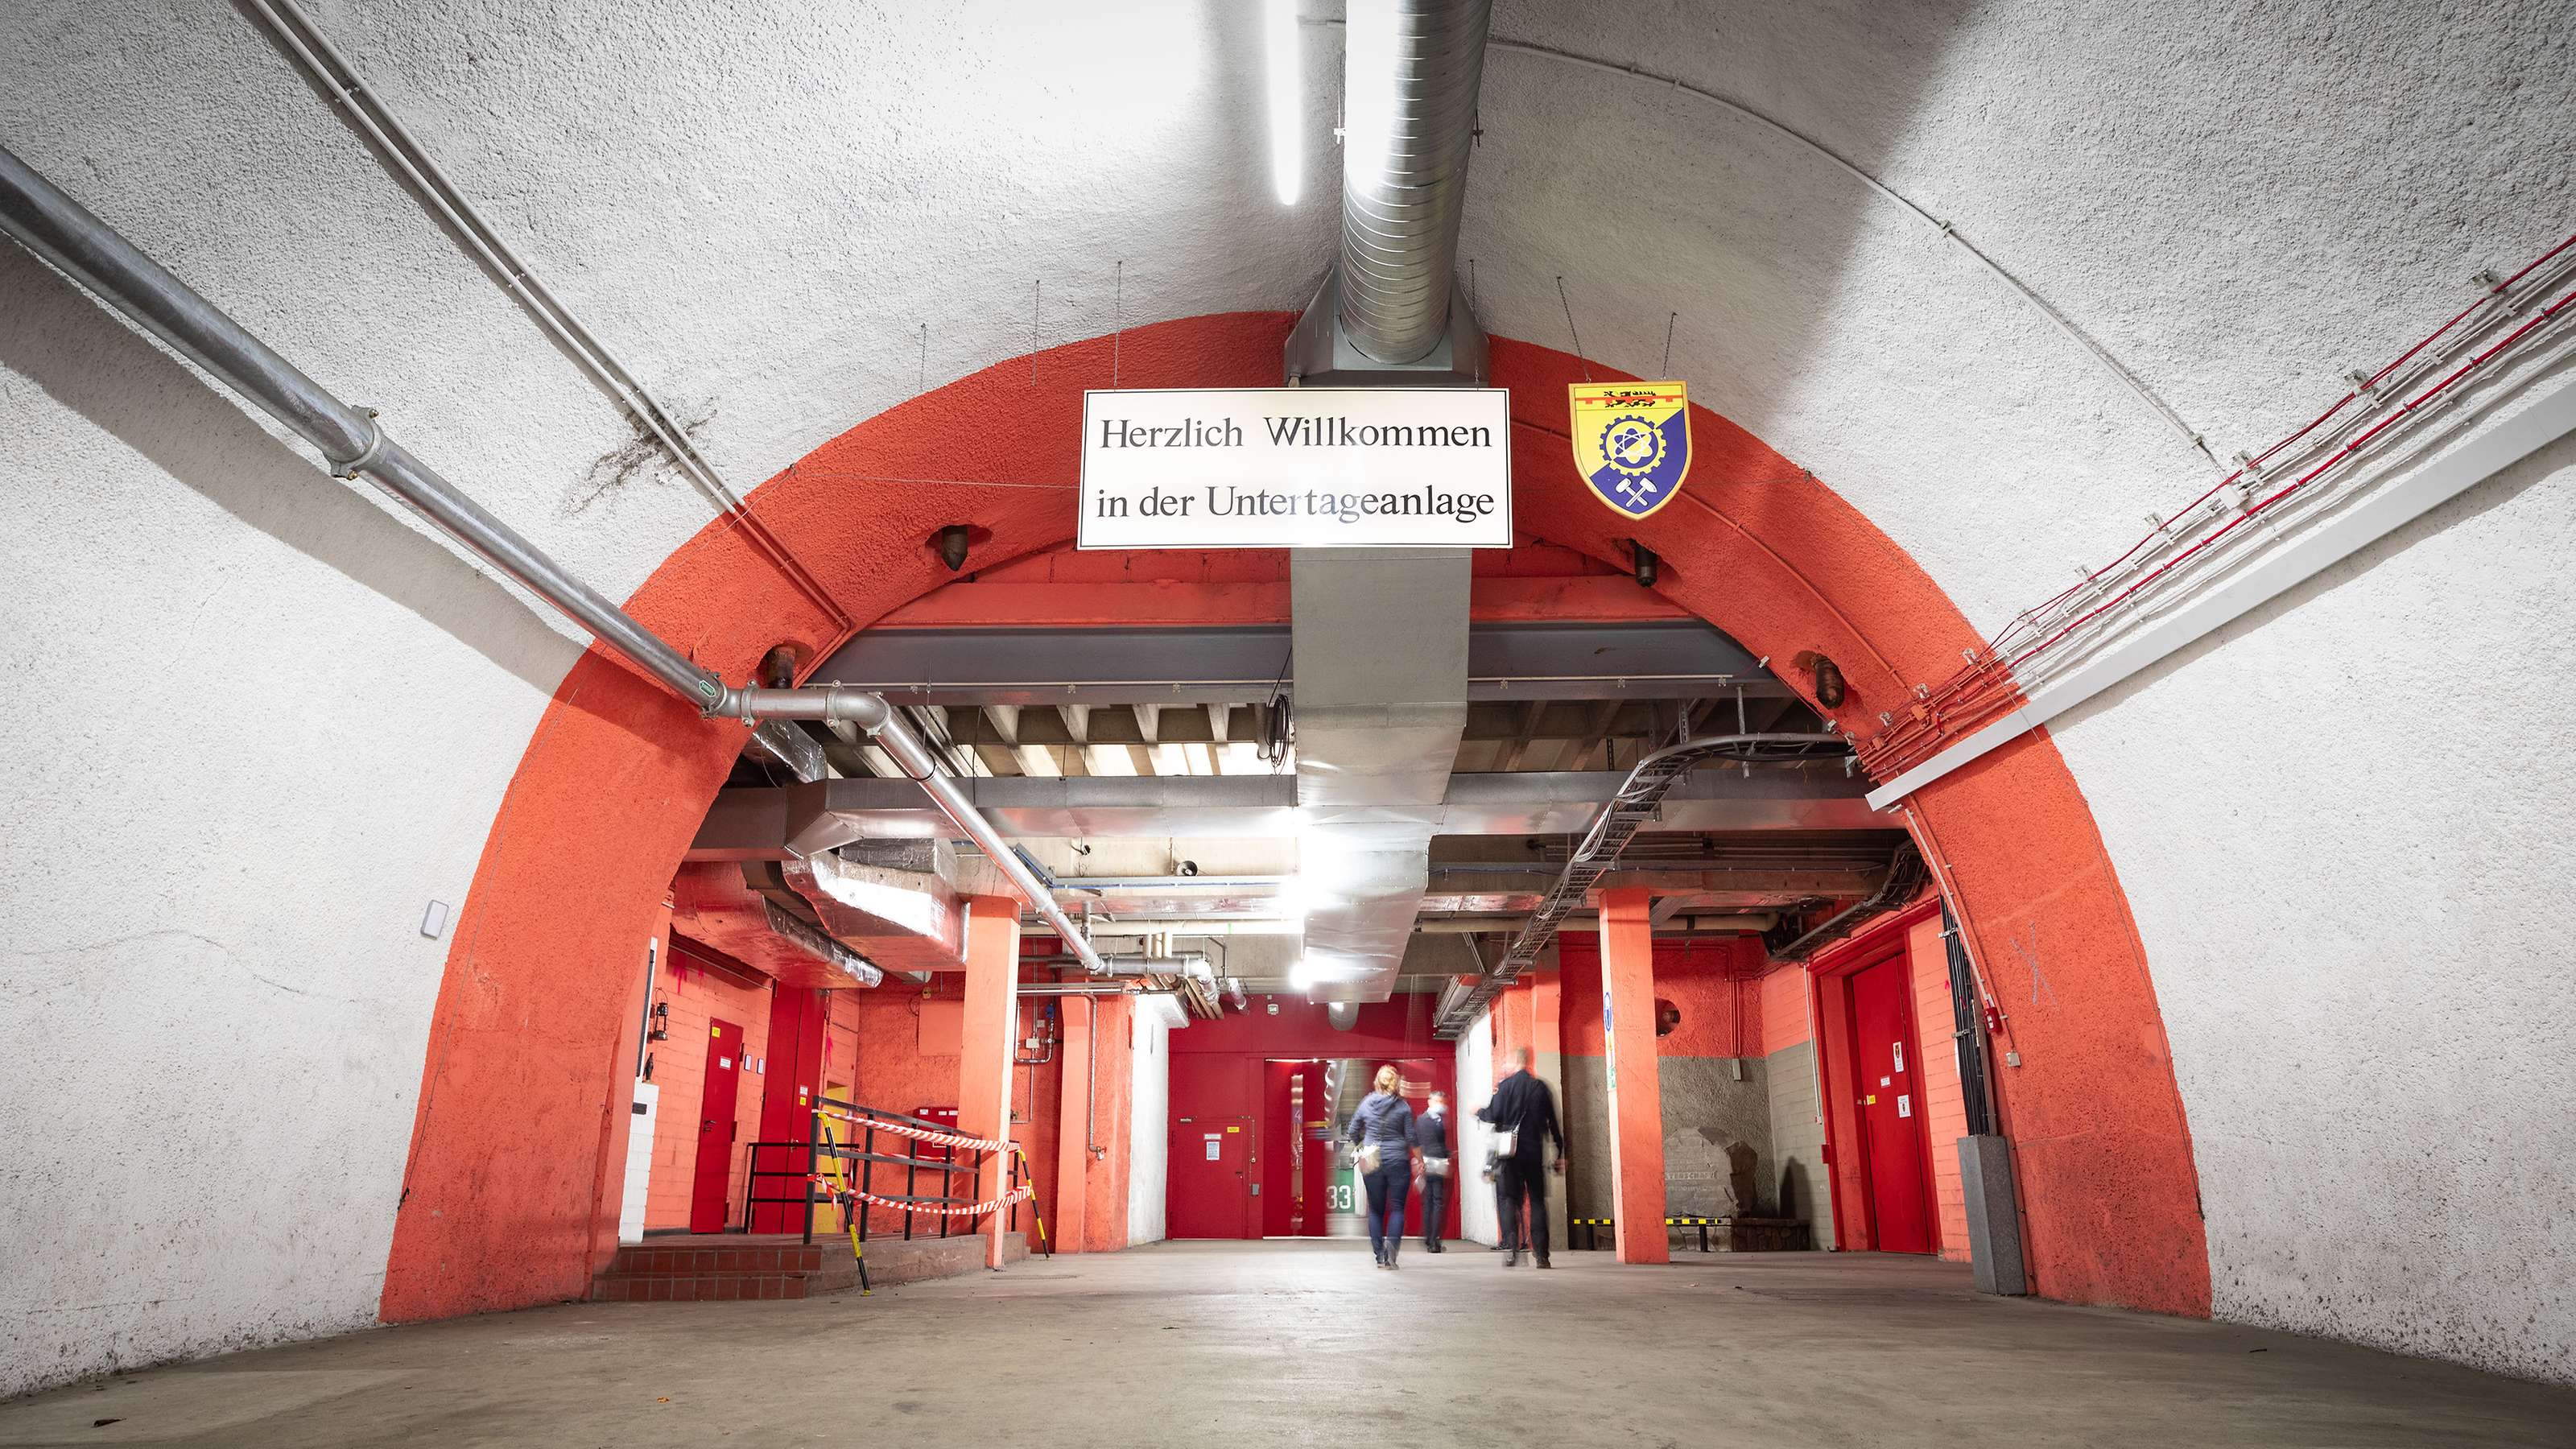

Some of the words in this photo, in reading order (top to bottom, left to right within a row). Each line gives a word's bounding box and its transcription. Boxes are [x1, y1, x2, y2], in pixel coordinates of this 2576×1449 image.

[1100, 417, 1244, 448] Herzlich
[1264, 416, 1492, 448] Willkommen
[1097, 489, 1128, 518] in
[1139, 485, 1196, 517] der
[1208, 484, 1495, 524] Untertageanlage
[1326, 1185, 1352, 1209] 33
